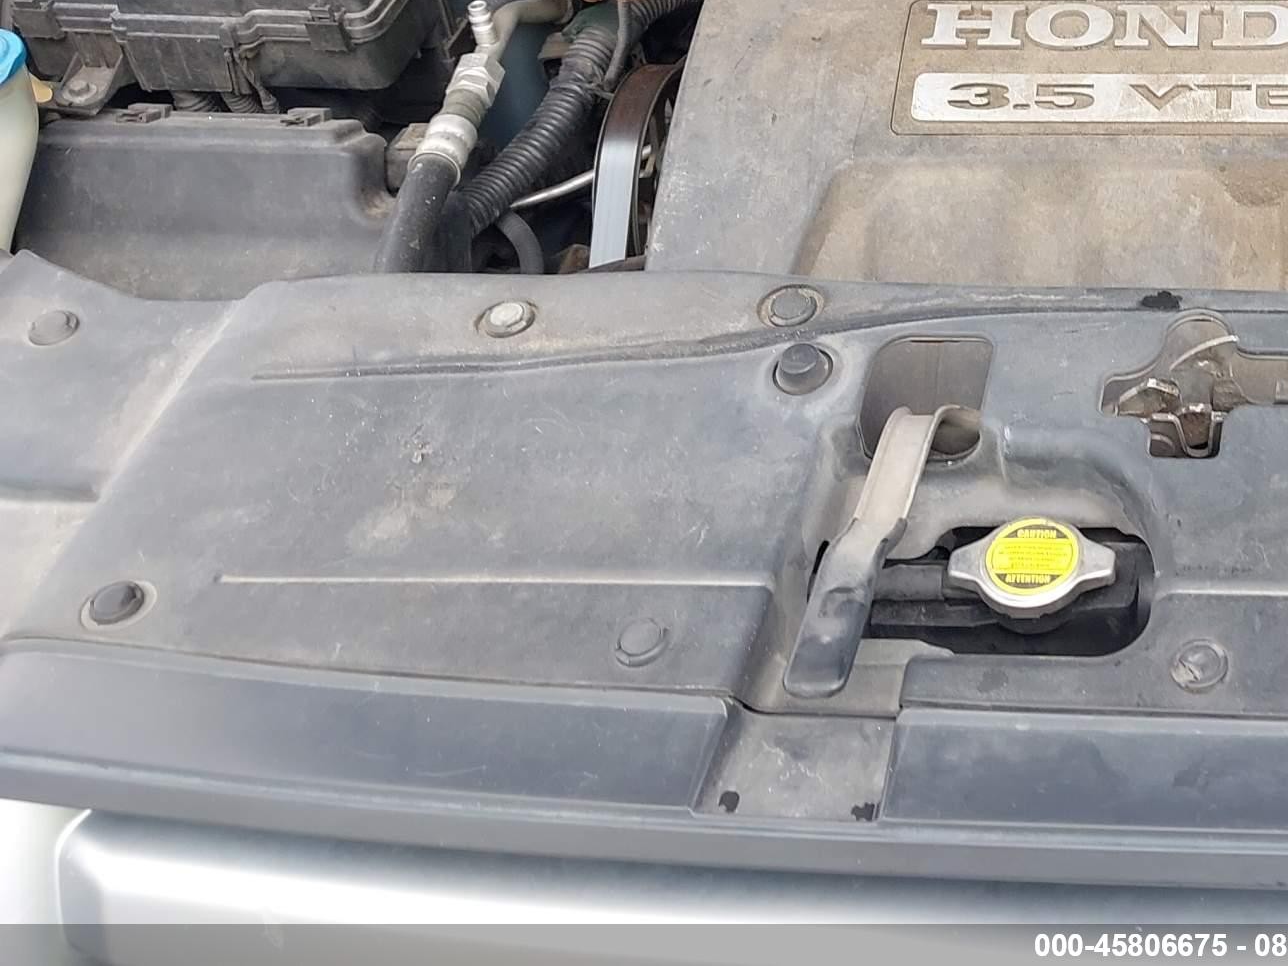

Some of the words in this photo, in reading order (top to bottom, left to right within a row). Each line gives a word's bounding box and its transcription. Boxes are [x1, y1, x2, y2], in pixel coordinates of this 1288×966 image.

[947, 82, 1096, 111] 3.5
[1016, 528, 1057, 538] CAUTION
[1005, 574, 1051, 584] ATTENTION
